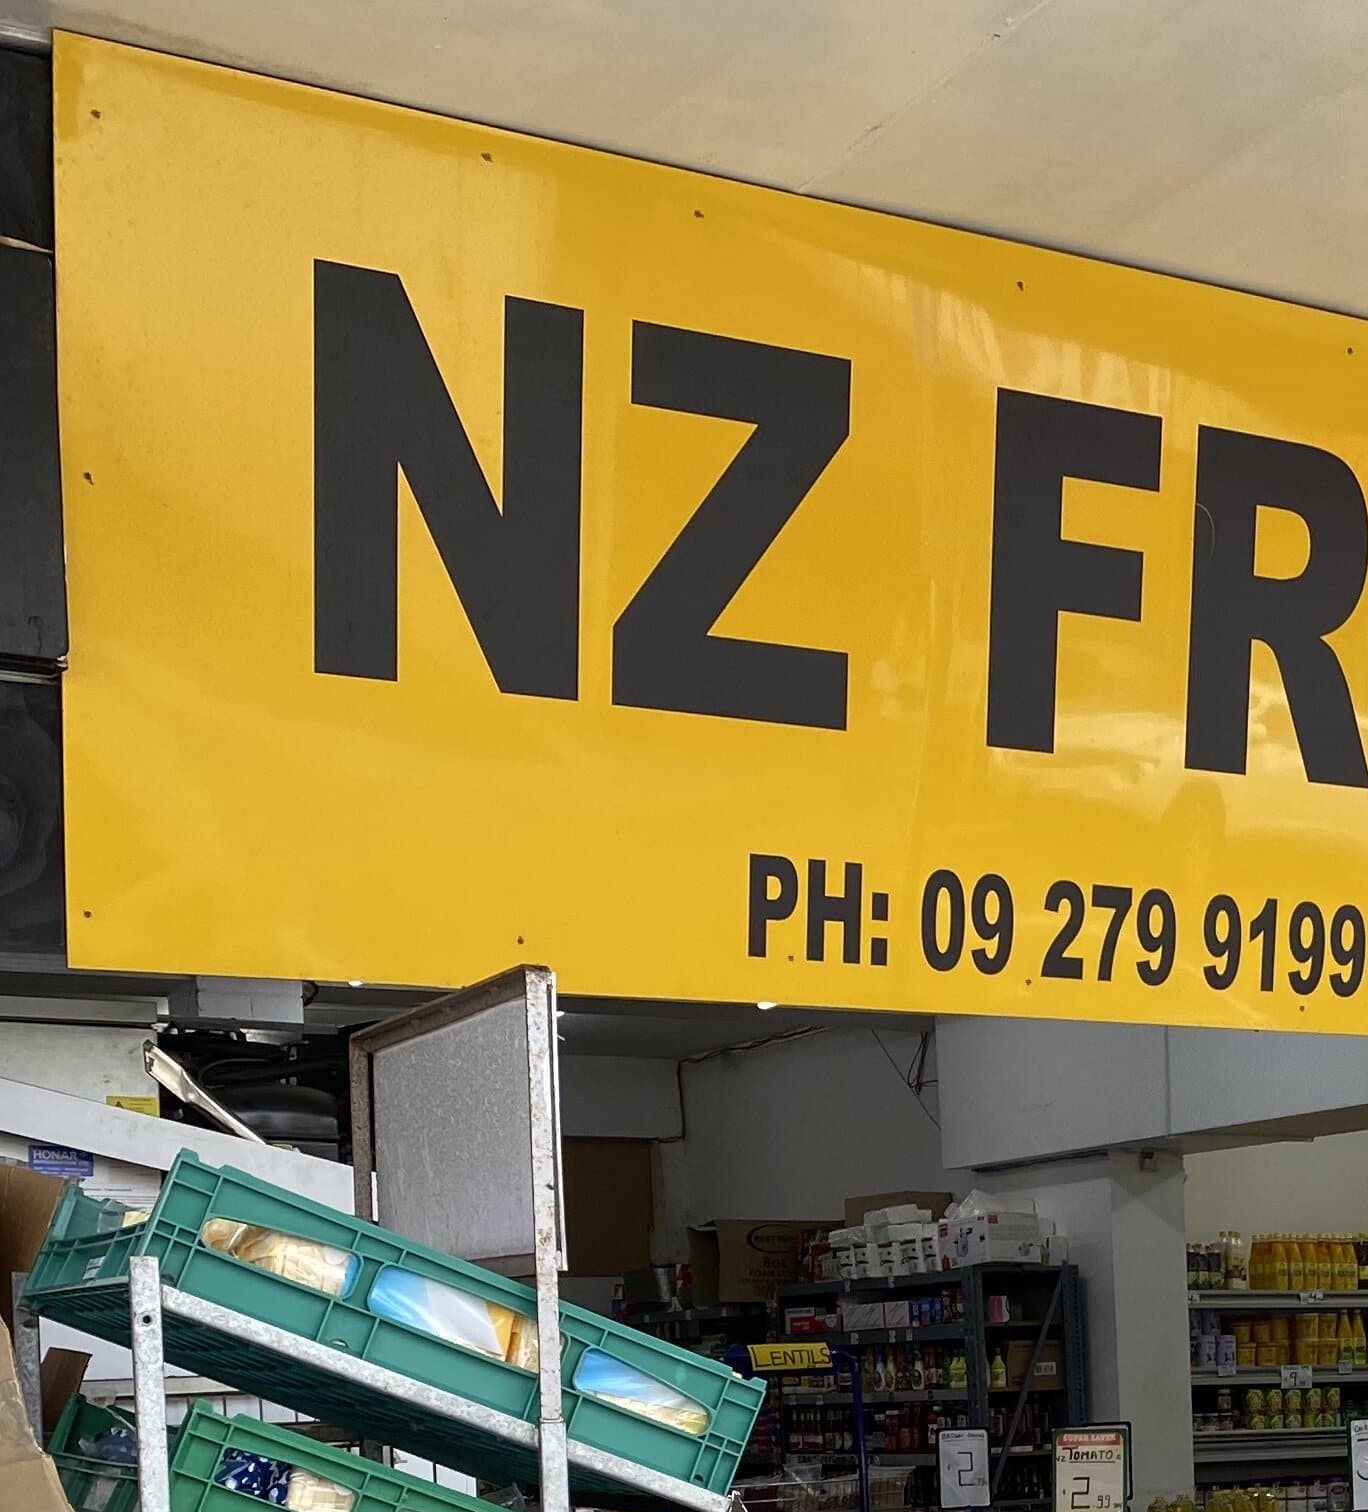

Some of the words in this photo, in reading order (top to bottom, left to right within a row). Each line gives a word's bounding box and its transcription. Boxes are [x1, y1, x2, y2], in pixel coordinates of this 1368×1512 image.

[313, 258, 852, 731] NZ
[748, 853, 889, 966] PH:
[921, 869, 1014, 975] 09
[1040, 880, 1177, 986] 279
[1203, 894, 1366, 998] 9199
[752, 1347, 832, 1368] LENTILS
